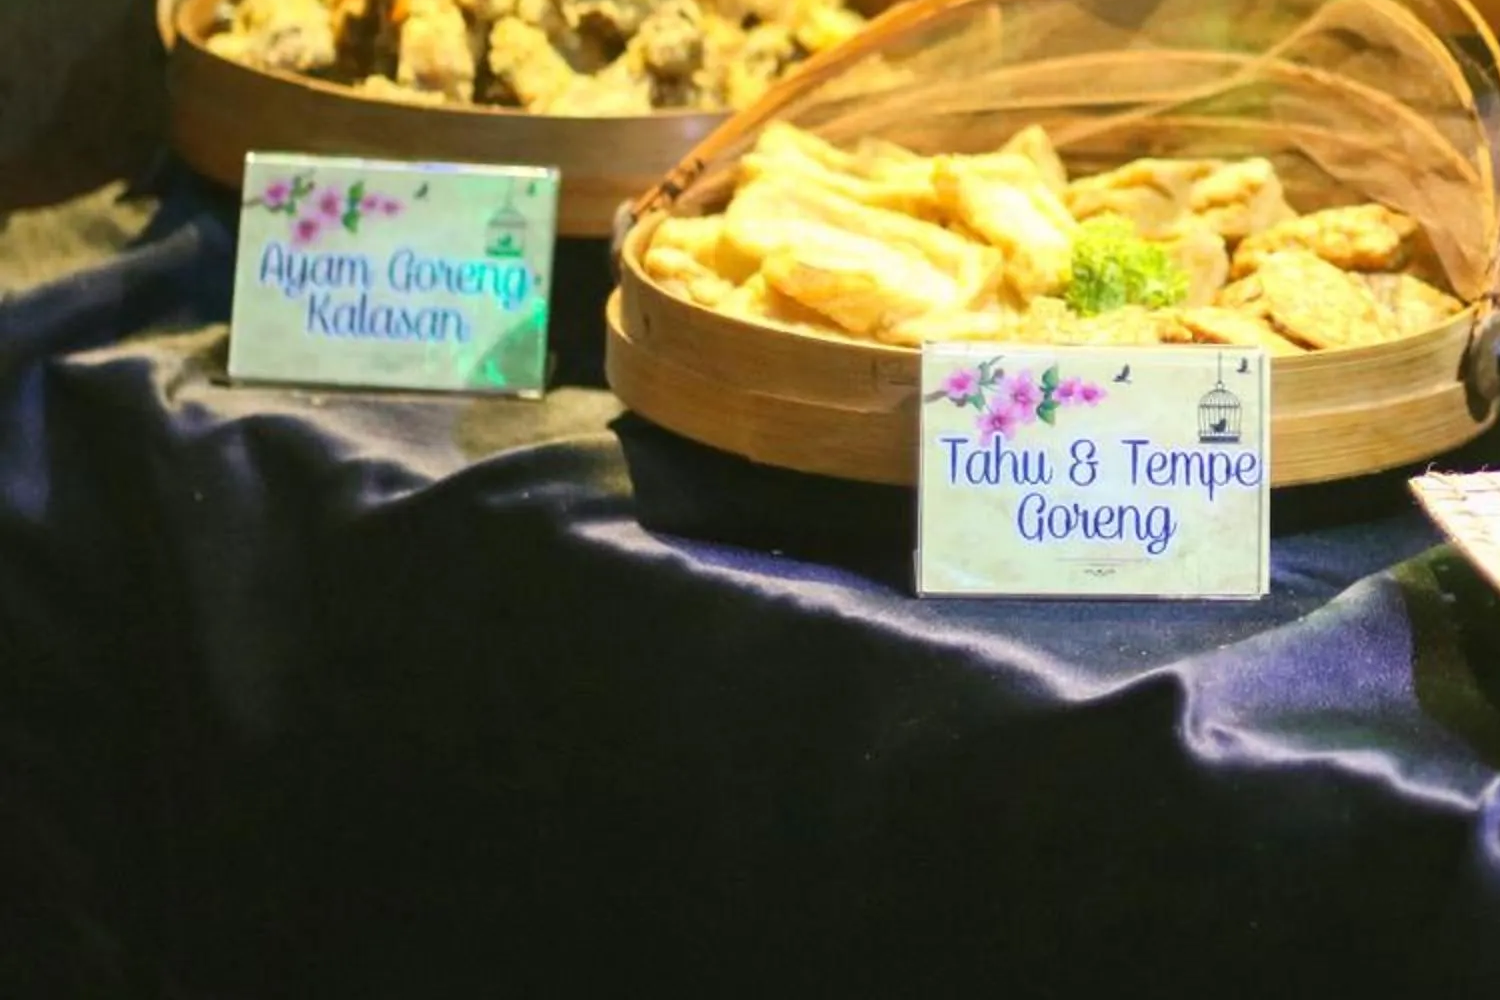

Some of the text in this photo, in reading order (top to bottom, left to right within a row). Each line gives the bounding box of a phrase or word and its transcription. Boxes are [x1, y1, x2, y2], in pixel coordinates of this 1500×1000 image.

[259, 242, 530, 310] Ayam Goreng
[306, 295, 466, 343] Kalasan
[940, 435, 1264, 501] Tahu & Tempe
[1017, 493, 1178, 555] Goreng
